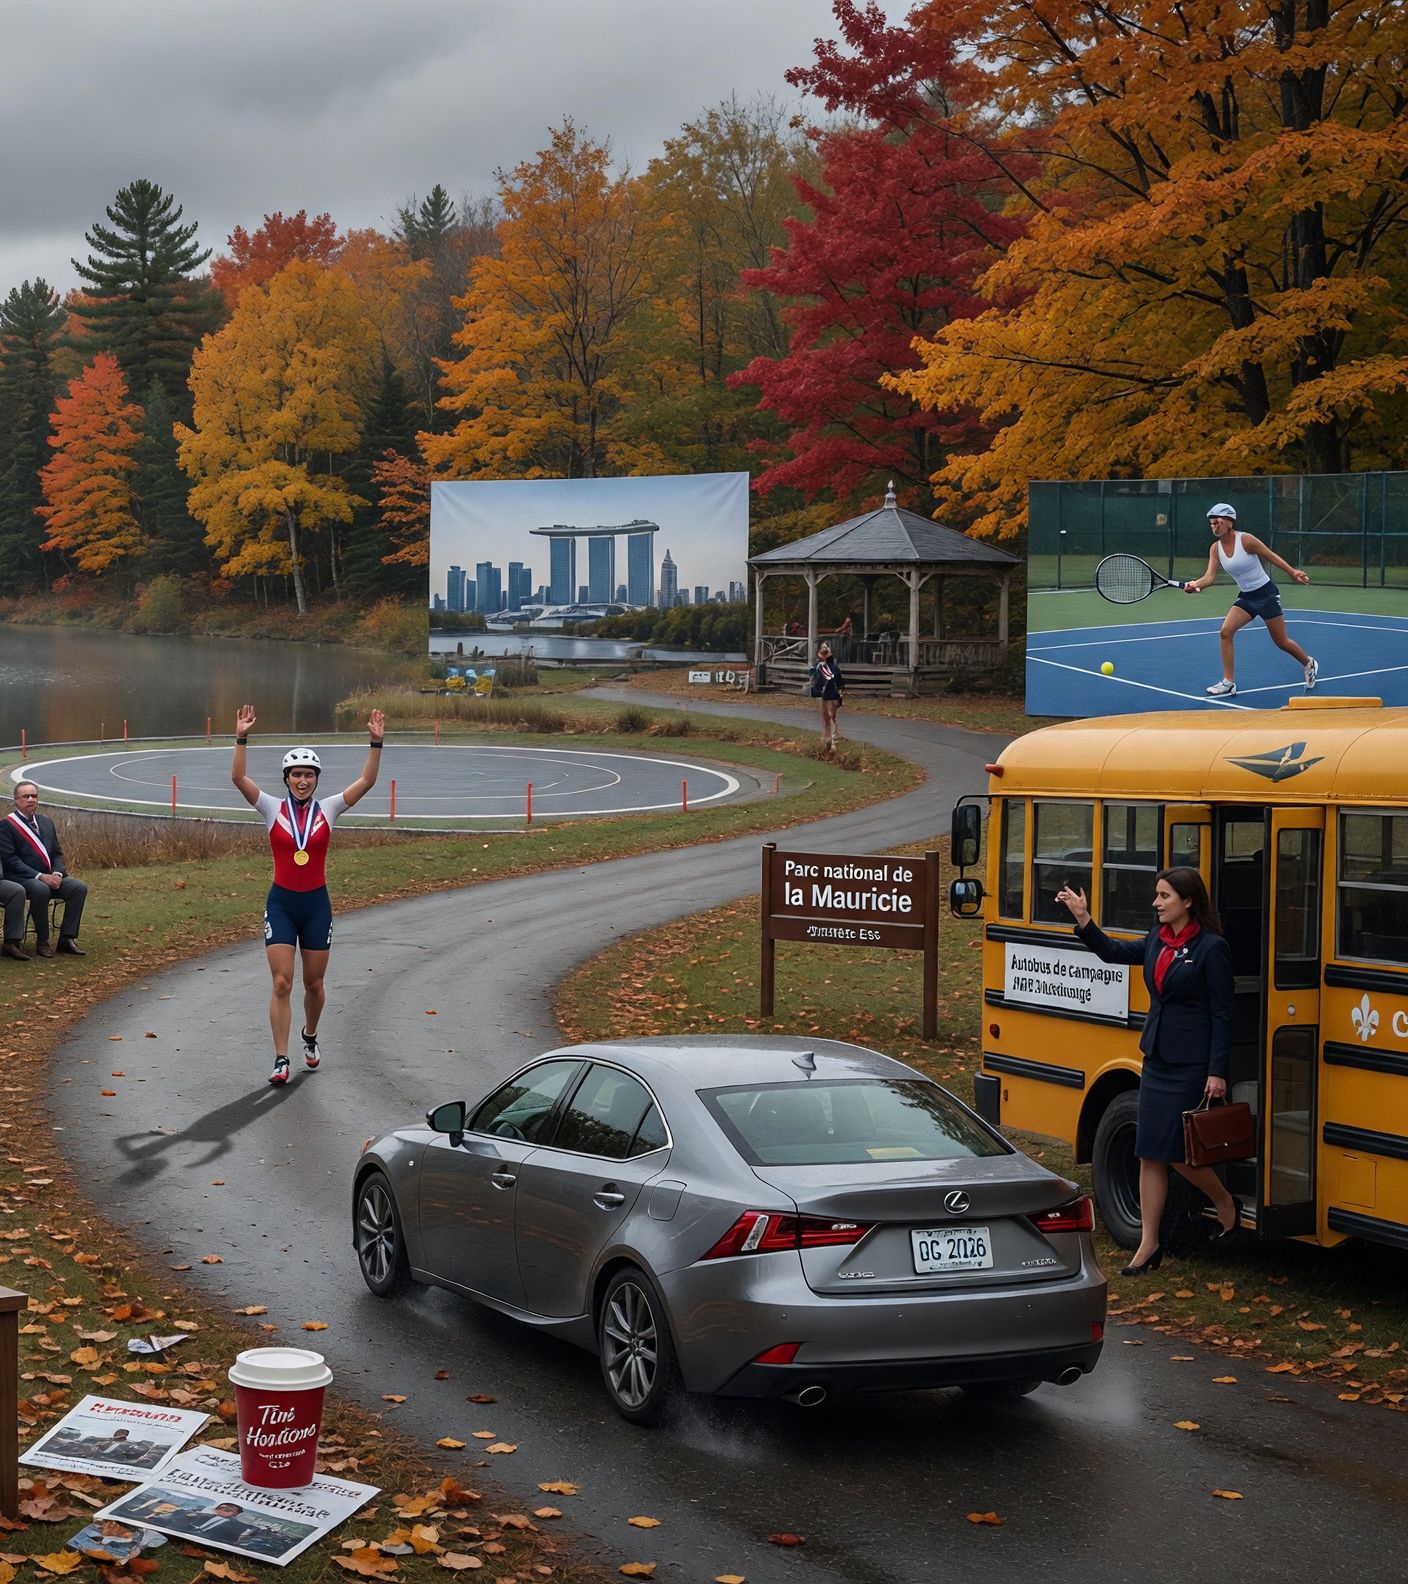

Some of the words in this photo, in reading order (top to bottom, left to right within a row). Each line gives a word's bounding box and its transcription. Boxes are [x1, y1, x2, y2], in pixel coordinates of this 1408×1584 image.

[784, 860, 819, 878] Parc
[823, 863, 888, 882] national
[892, 866, 913, 883] de
[784, 882, 804, 906] la
[811, 884, 913, 913] Mauricie
[1053, 959, 1067, 977] de
